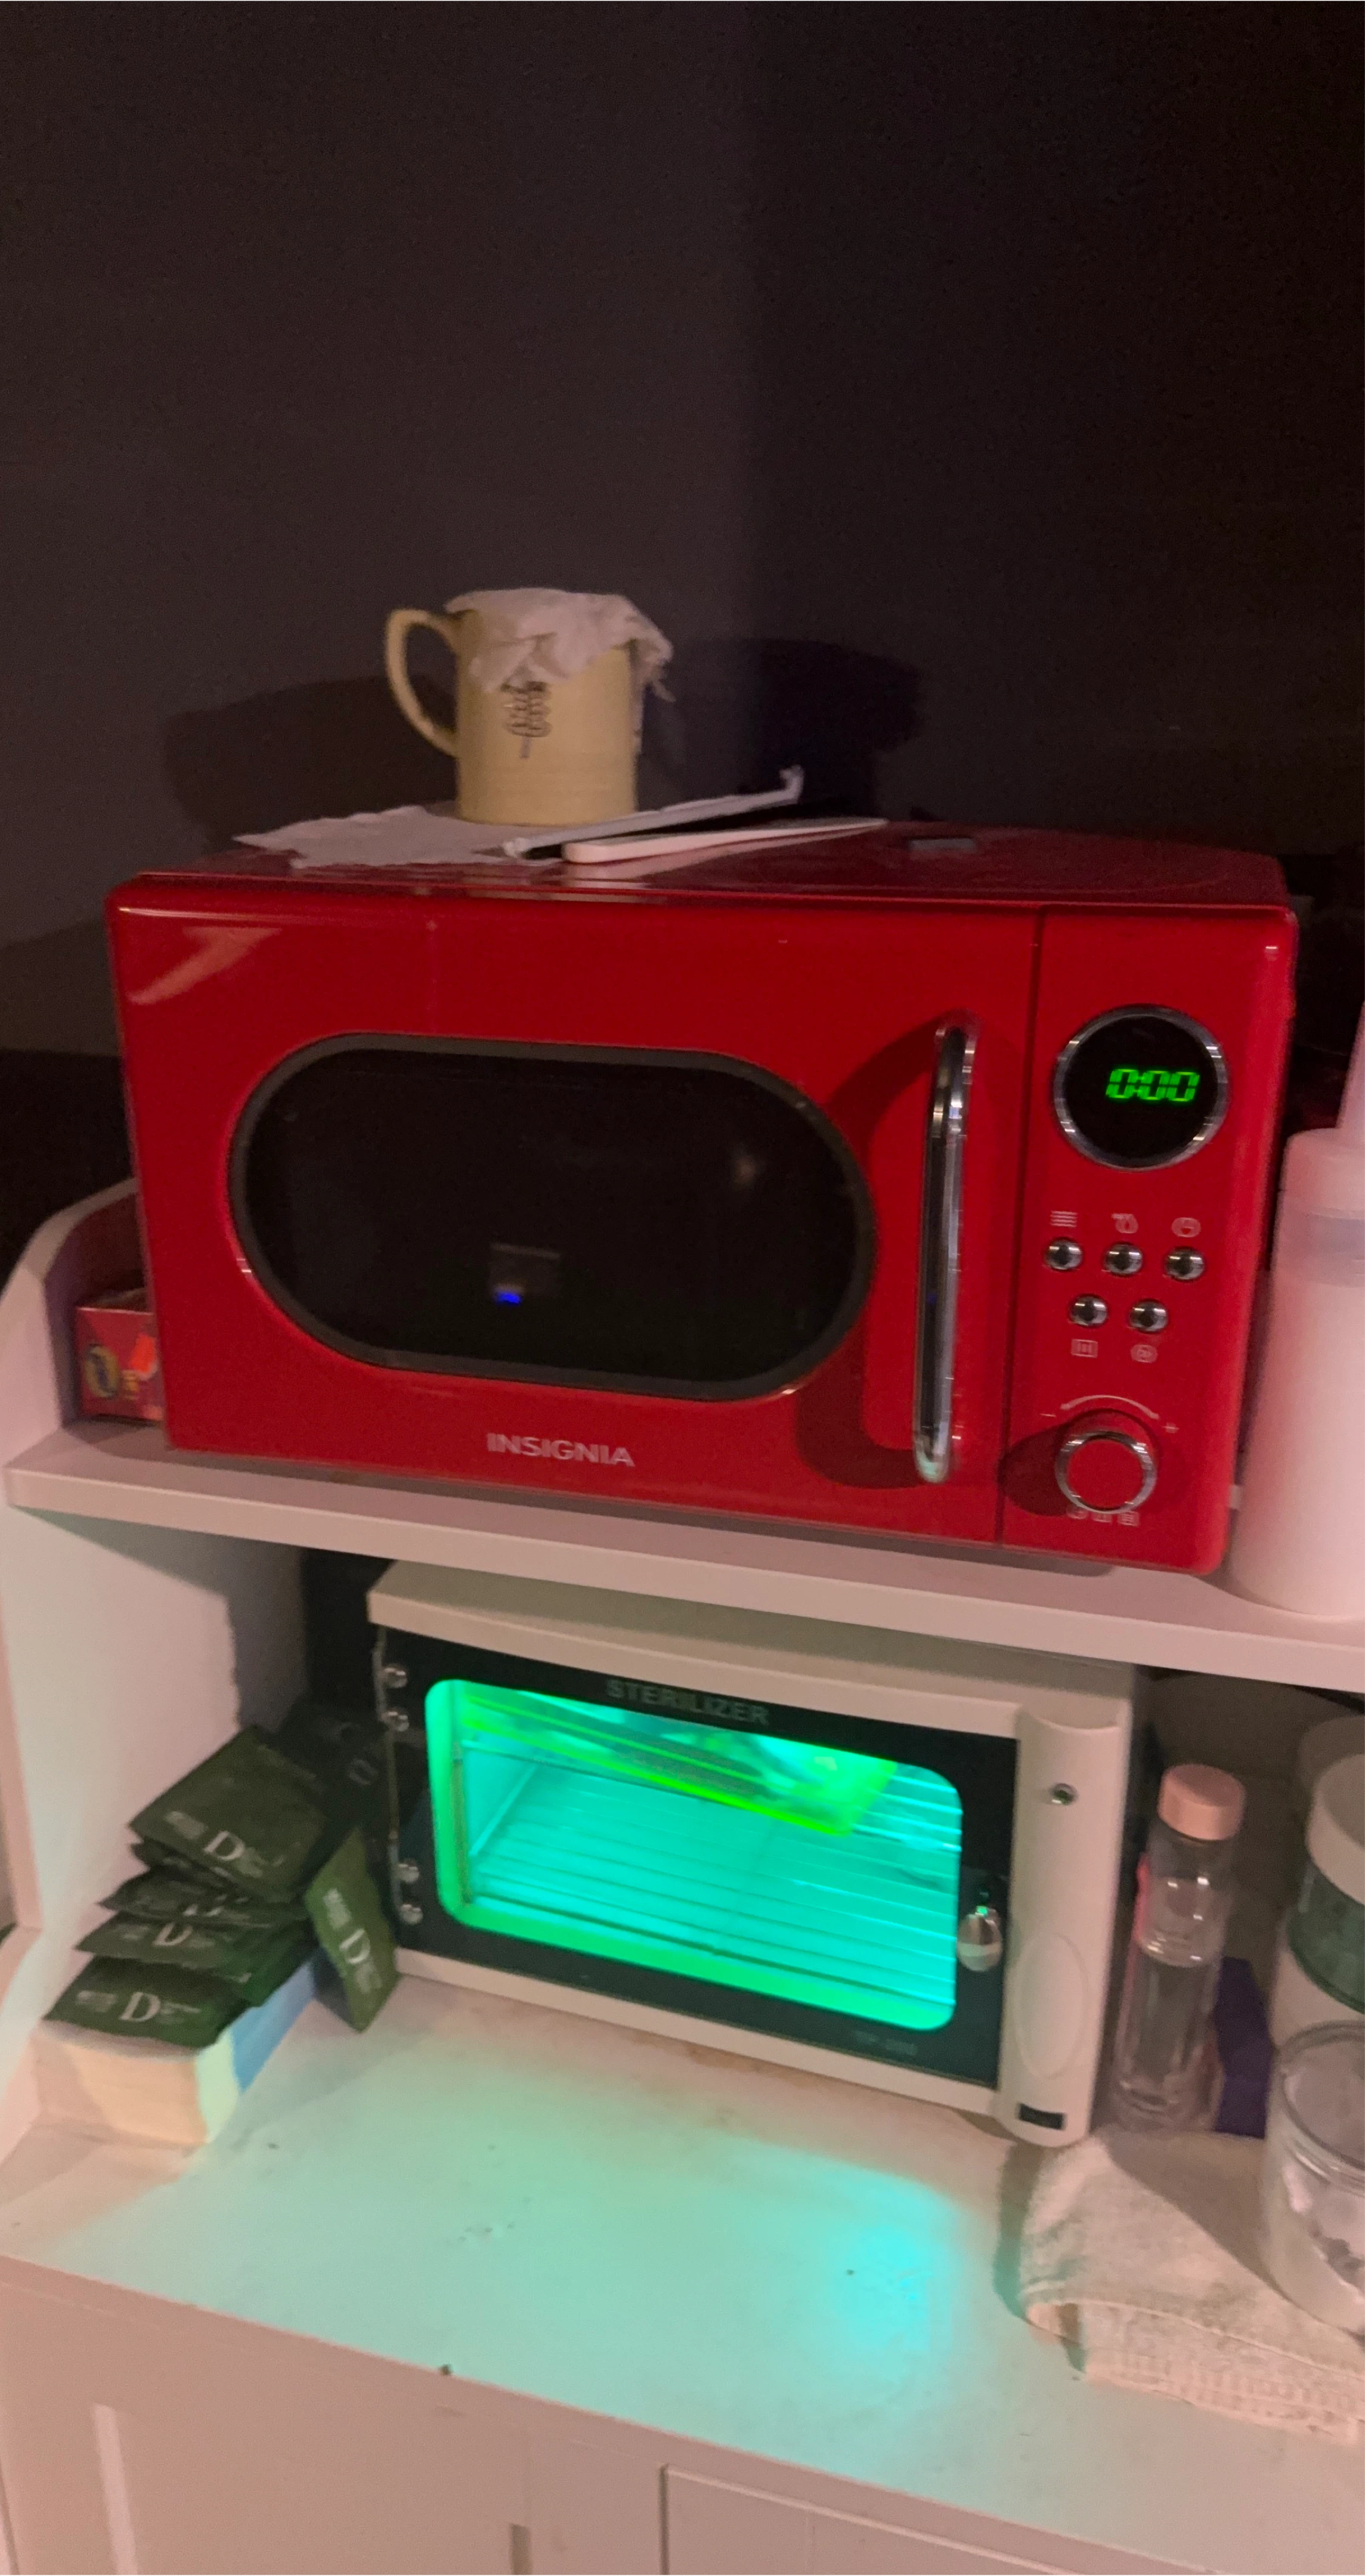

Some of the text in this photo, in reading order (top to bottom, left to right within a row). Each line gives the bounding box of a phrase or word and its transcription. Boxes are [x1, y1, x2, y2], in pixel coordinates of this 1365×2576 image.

[1106, 1069, 1200, 1102] 0:00
[486, 1432, 636, 1467] INSIGNIA
[606, 1678, 770, 1725] STERILIZER
